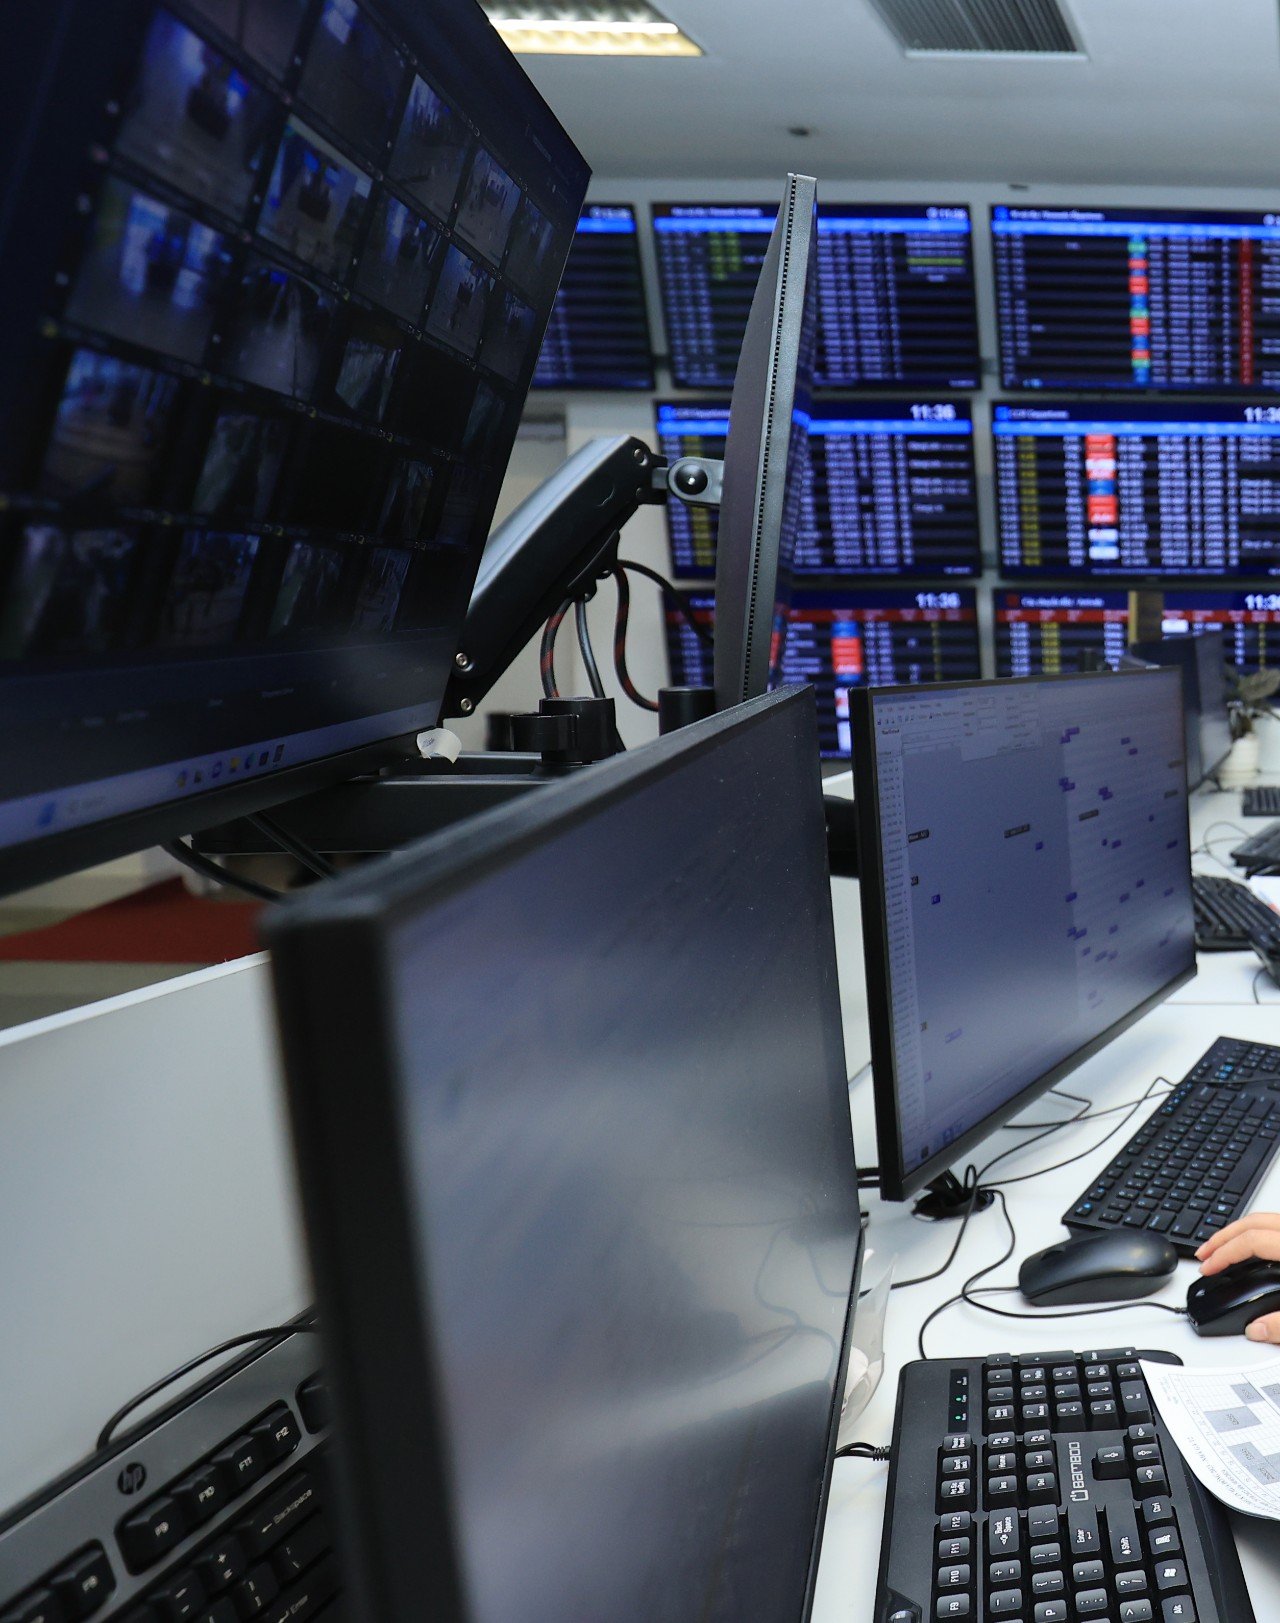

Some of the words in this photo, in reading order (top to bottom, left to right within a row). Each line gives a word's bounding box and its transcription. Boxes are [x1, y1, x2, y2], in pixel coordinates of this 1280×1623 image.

[910, 404, 956, 420] 11:36
[915, 592, 960, 609] 11:36
[275, 1426, 289, 1442] F12
[238, 1456, 253, 1472] F11
[199, 1485, 215, 1503] F10
[951, 1516, 961, 1528] F12
[994, 1520, 1003, 1535] Back
[1003, 1516, 1014, 1533] Space
[950, 1542, 960, 1554] F11
[950, 1570, 960, 1583] F10
[949, 1601, 960, 1611] F9
[1045, 1609, 1056, 1617] P
